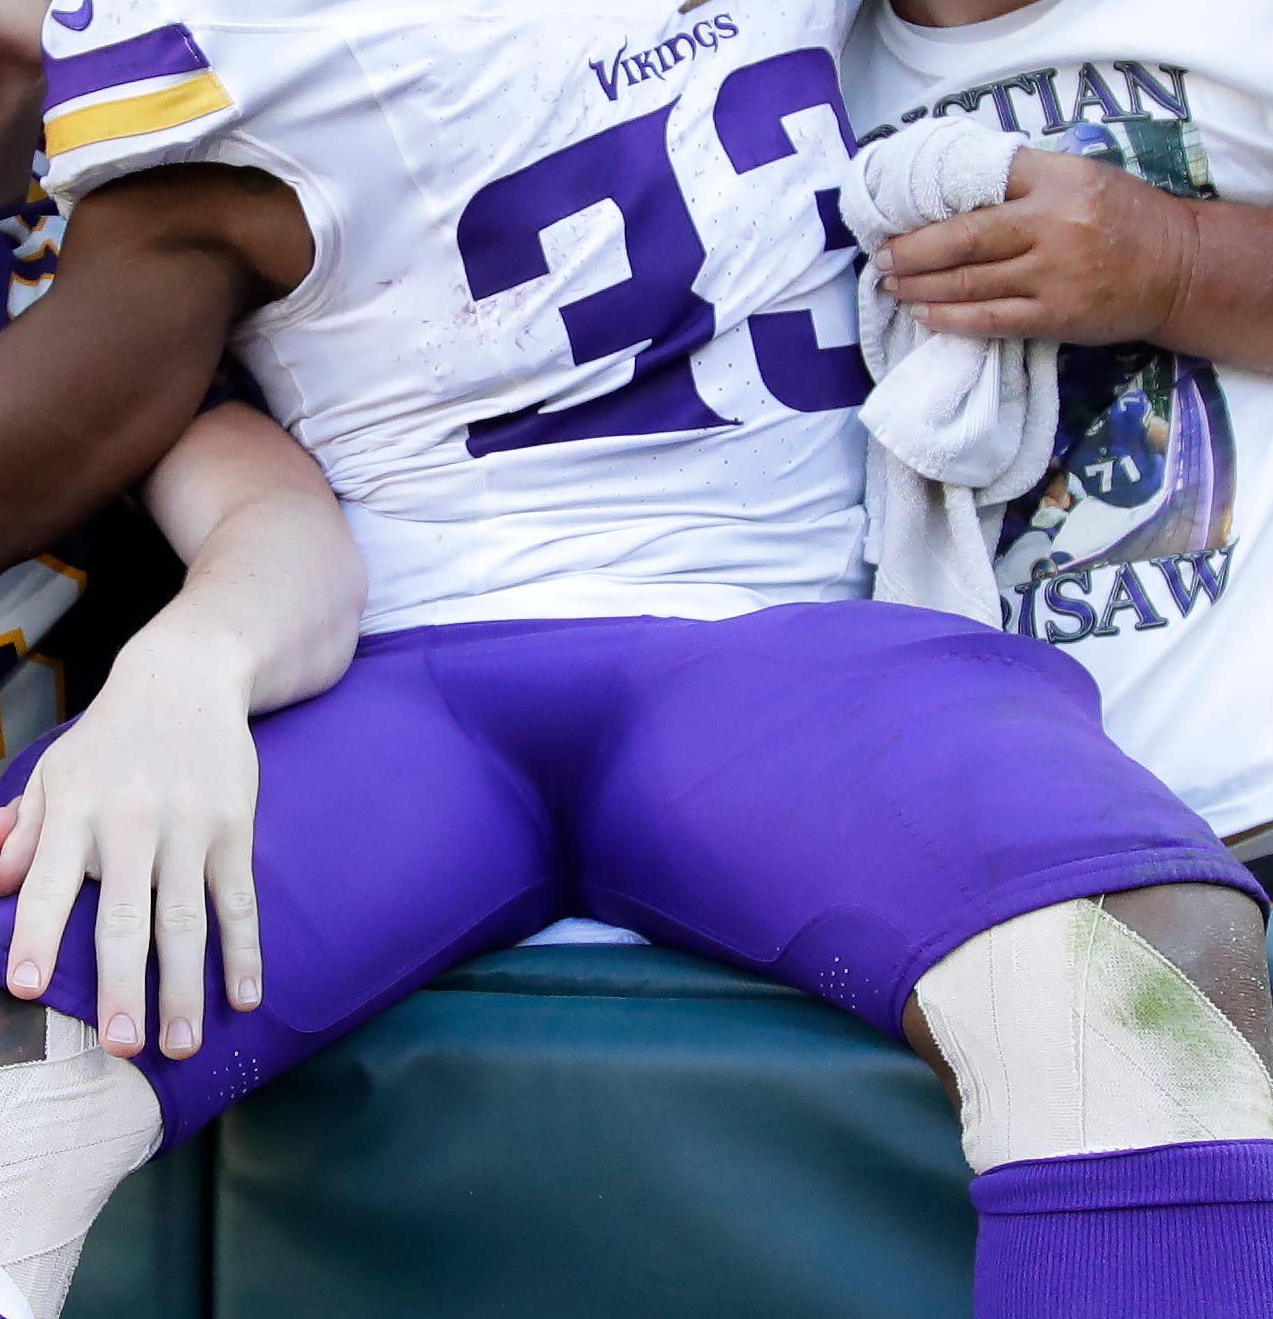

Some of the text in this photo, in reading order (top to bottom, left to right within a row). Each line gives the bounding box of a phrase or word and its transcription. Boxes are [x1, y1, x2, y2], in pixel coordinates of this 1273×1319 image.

[588, 13, 740, 102] VIKINGS
[858, 60, 1192, 147] TIAN
[455, 47, 874, 458] 33
[1085, 454, 1142, 493] 71
